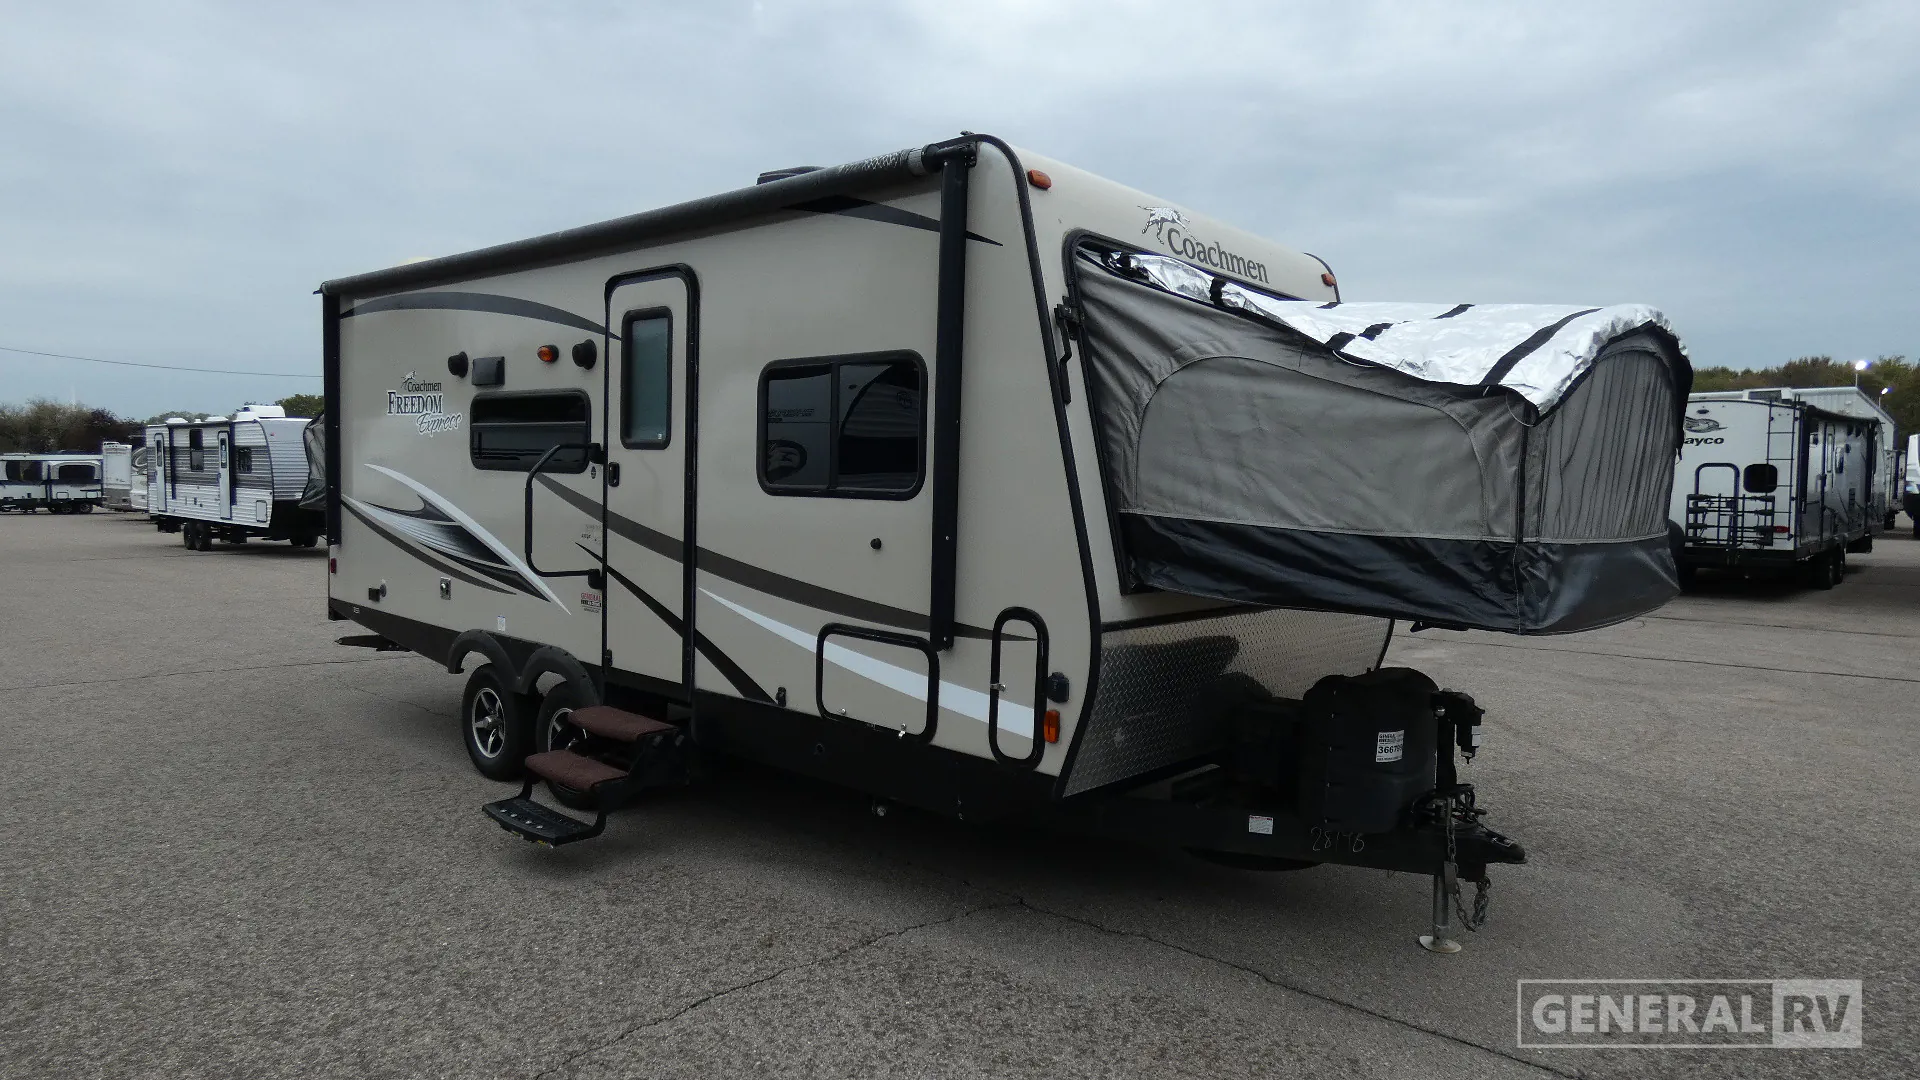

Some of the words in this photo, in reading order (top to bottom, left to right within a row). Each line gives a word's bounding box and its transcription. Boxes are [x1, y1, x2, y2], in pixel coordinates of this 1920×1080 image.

[1167, 227, 1269, 284] Coachmen
[407, 380, 442, 392] Coachmen
[387, 391, 443, 415] FREEDOM
[416, 412, 462, 437] Express
[1683, 437, 1725, 447] ayco
